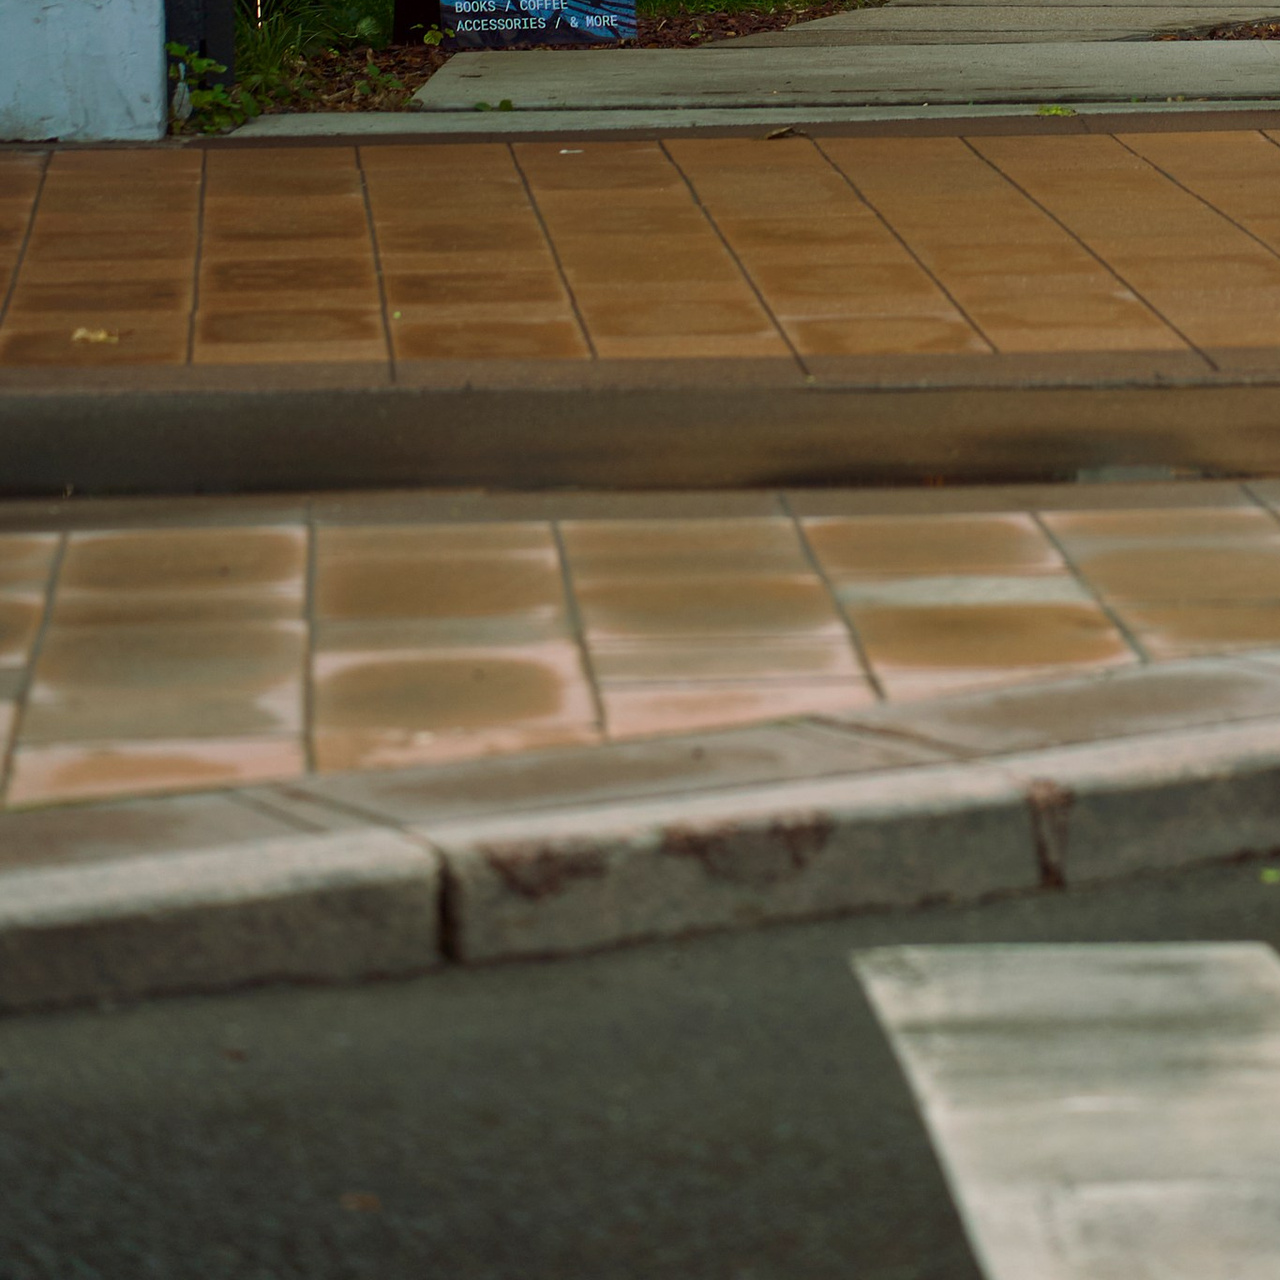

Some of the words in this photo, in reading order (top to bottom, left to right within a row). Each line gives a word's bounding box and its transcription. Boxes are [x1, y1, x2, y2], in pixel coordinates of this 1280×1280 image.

[455, 0, 496, 13] BOOKS
[505, 0, 511, 12] /
[456, 17, 546, 32] ACCESSORIES
[555, 17, 561, 29] /
[569, 17, 579, 28] &
[585, 14, 618, 27] MORE
